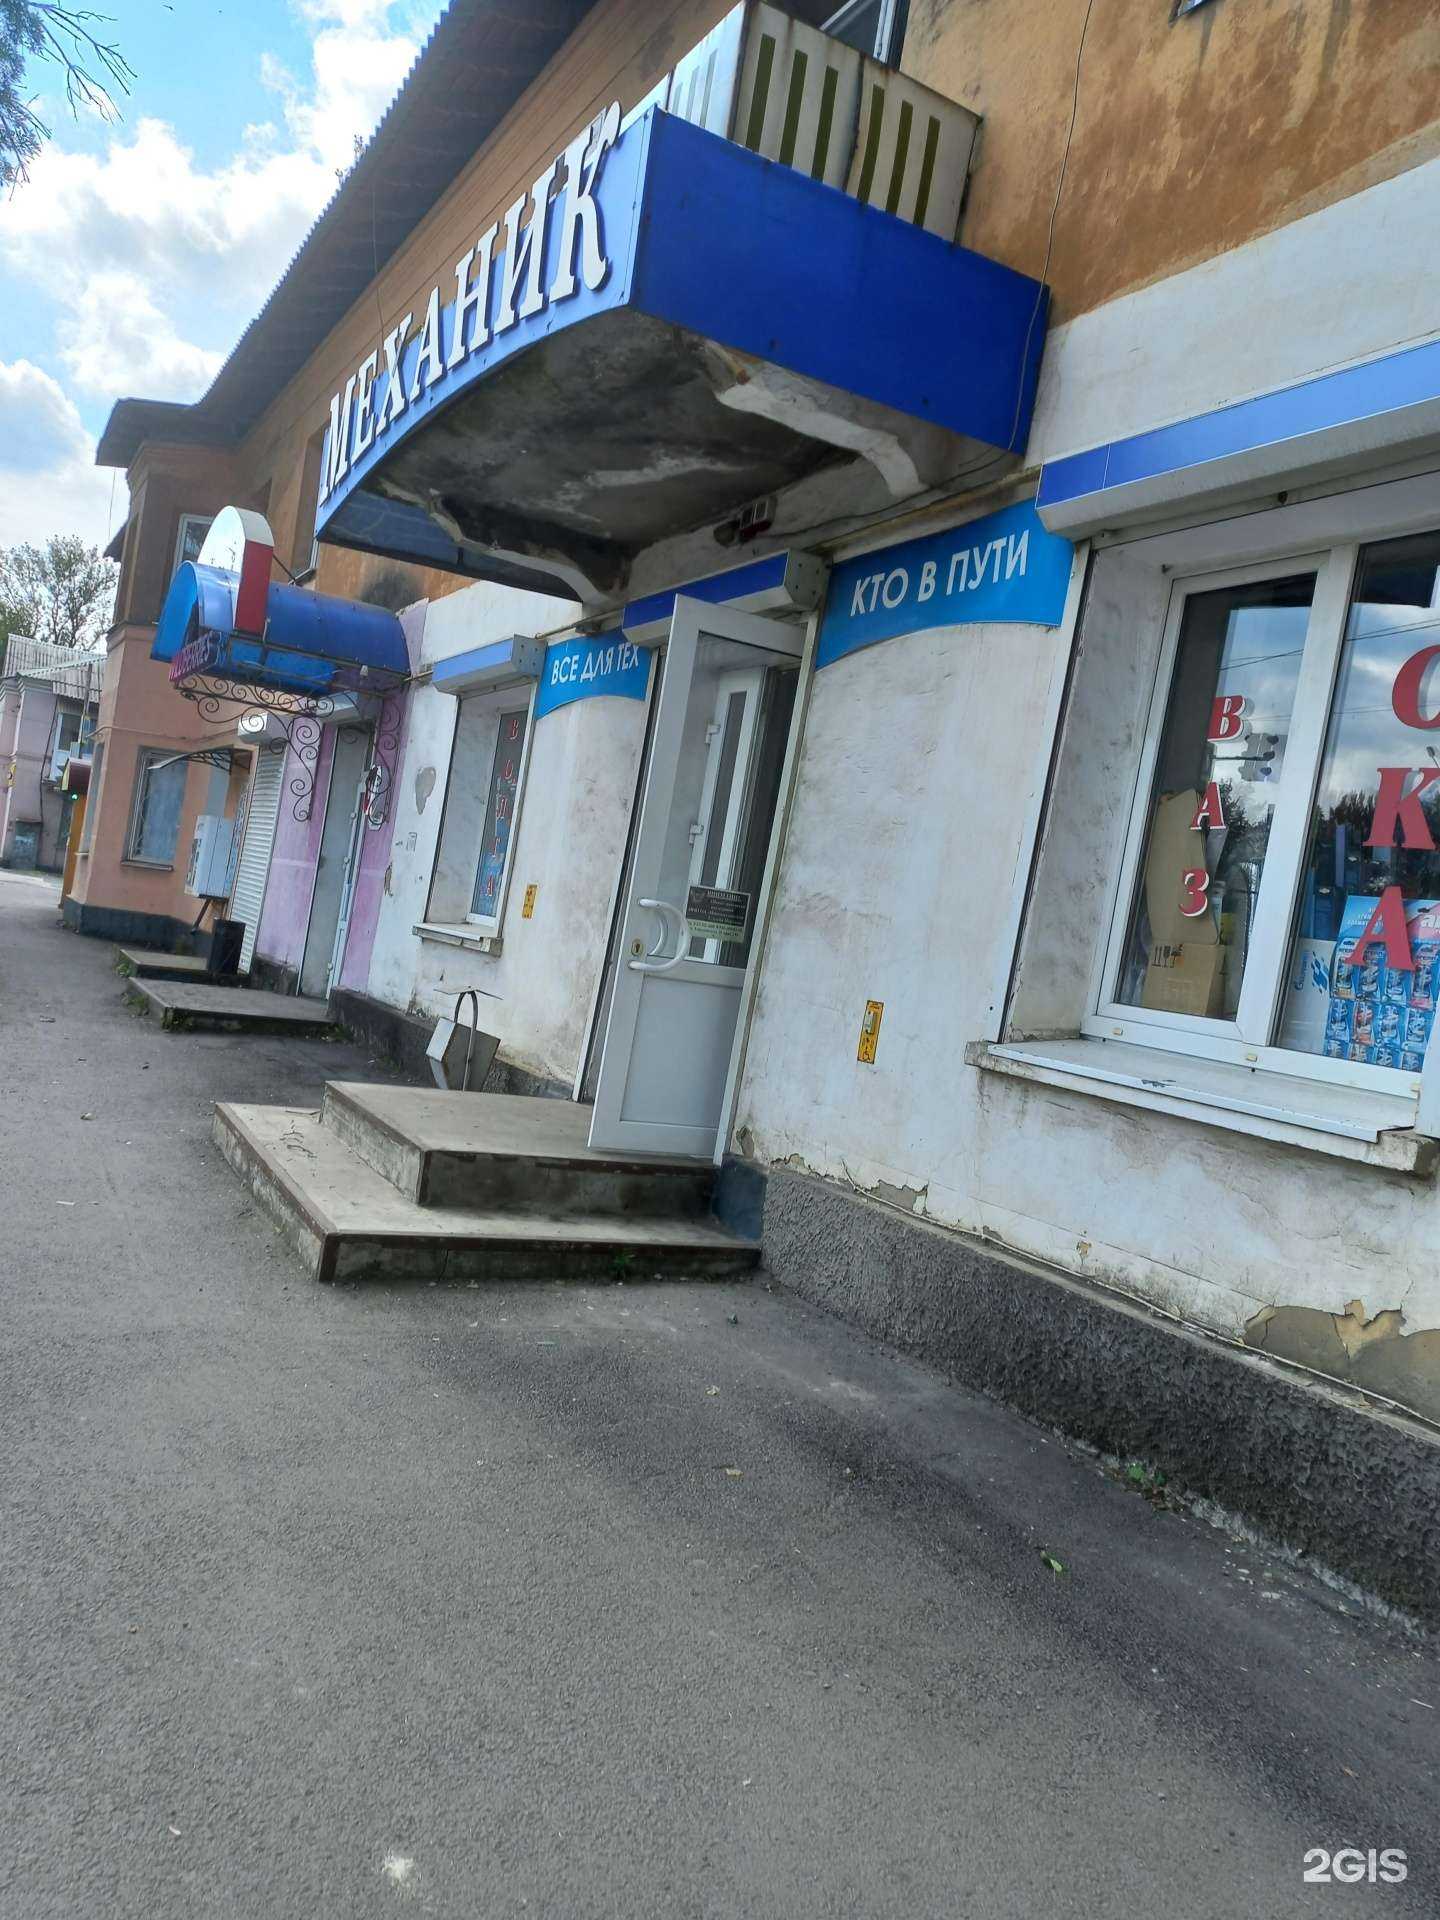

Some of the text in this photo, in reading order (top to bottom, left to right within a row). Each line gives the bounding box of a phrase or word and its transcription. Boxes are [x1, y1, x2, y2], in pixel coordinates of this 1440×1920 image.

[319, 101, 622, 507] МЕХАНИК
[850, 529, 1029, 617] КТО В ПУТИ
[550, 641, 640, 686] ВСЕ ДЛЯ ТЕХ
[1179, 695, 1247, 917] ВАЗ
